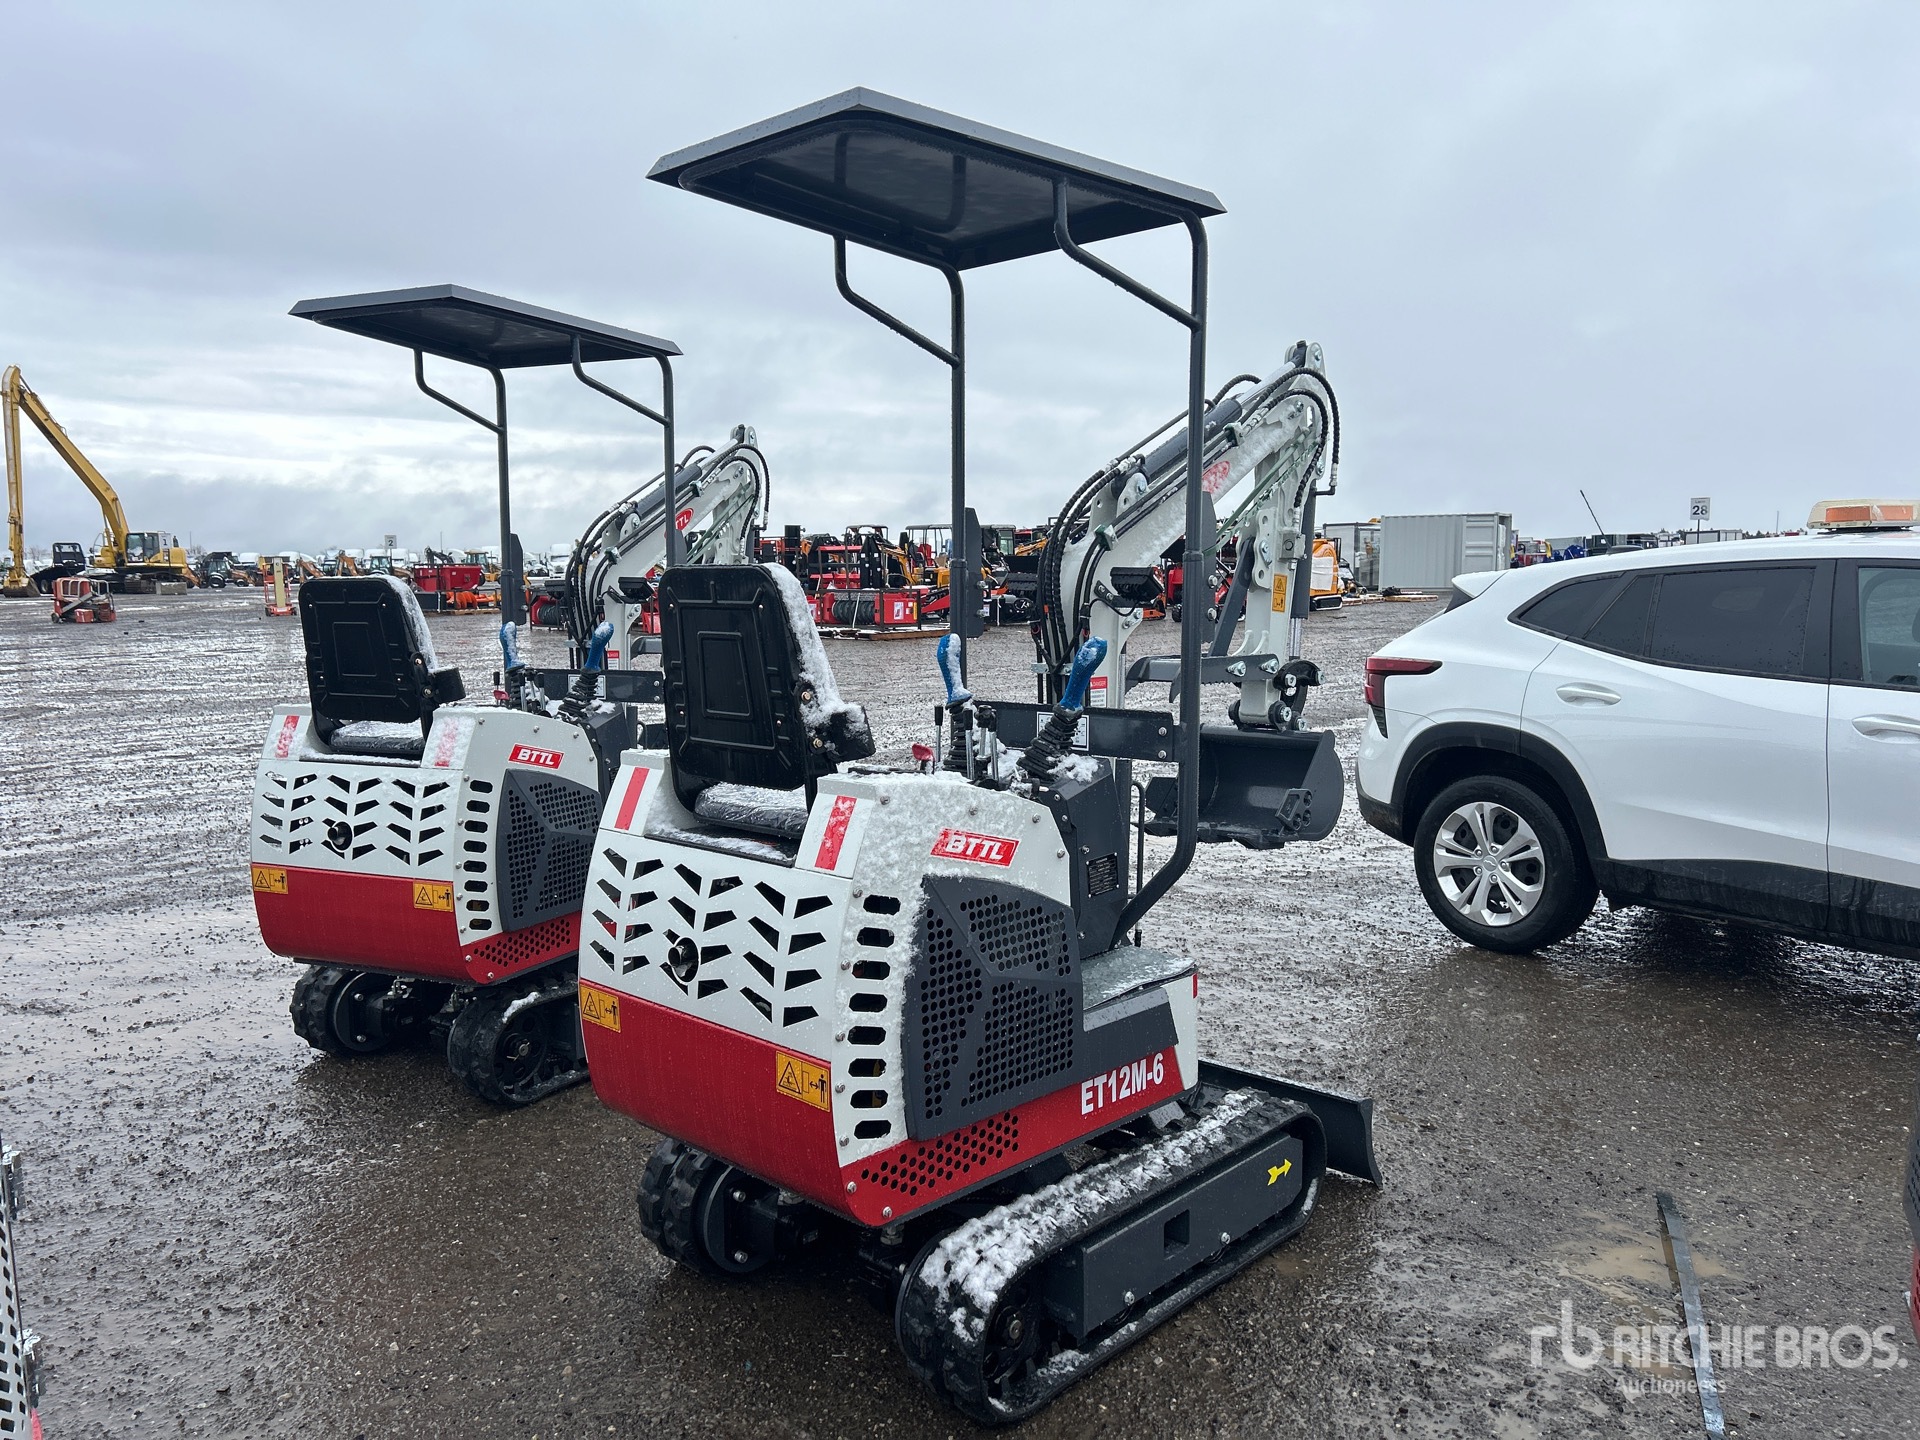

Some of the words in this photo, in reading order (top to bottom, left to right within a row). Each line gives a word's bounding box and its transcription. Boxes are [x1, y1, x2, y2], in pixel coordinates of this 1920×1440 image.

[1692, 505, 1708, 515] 28
[162, 538, 168, 546] 1
[388, 539, 394, 547] 2
[517, 748, 555, 765] BTTL
[945, 834, 1004, 860] BTTL
[1081, 1052, 1164, 1115] ET12M-6
